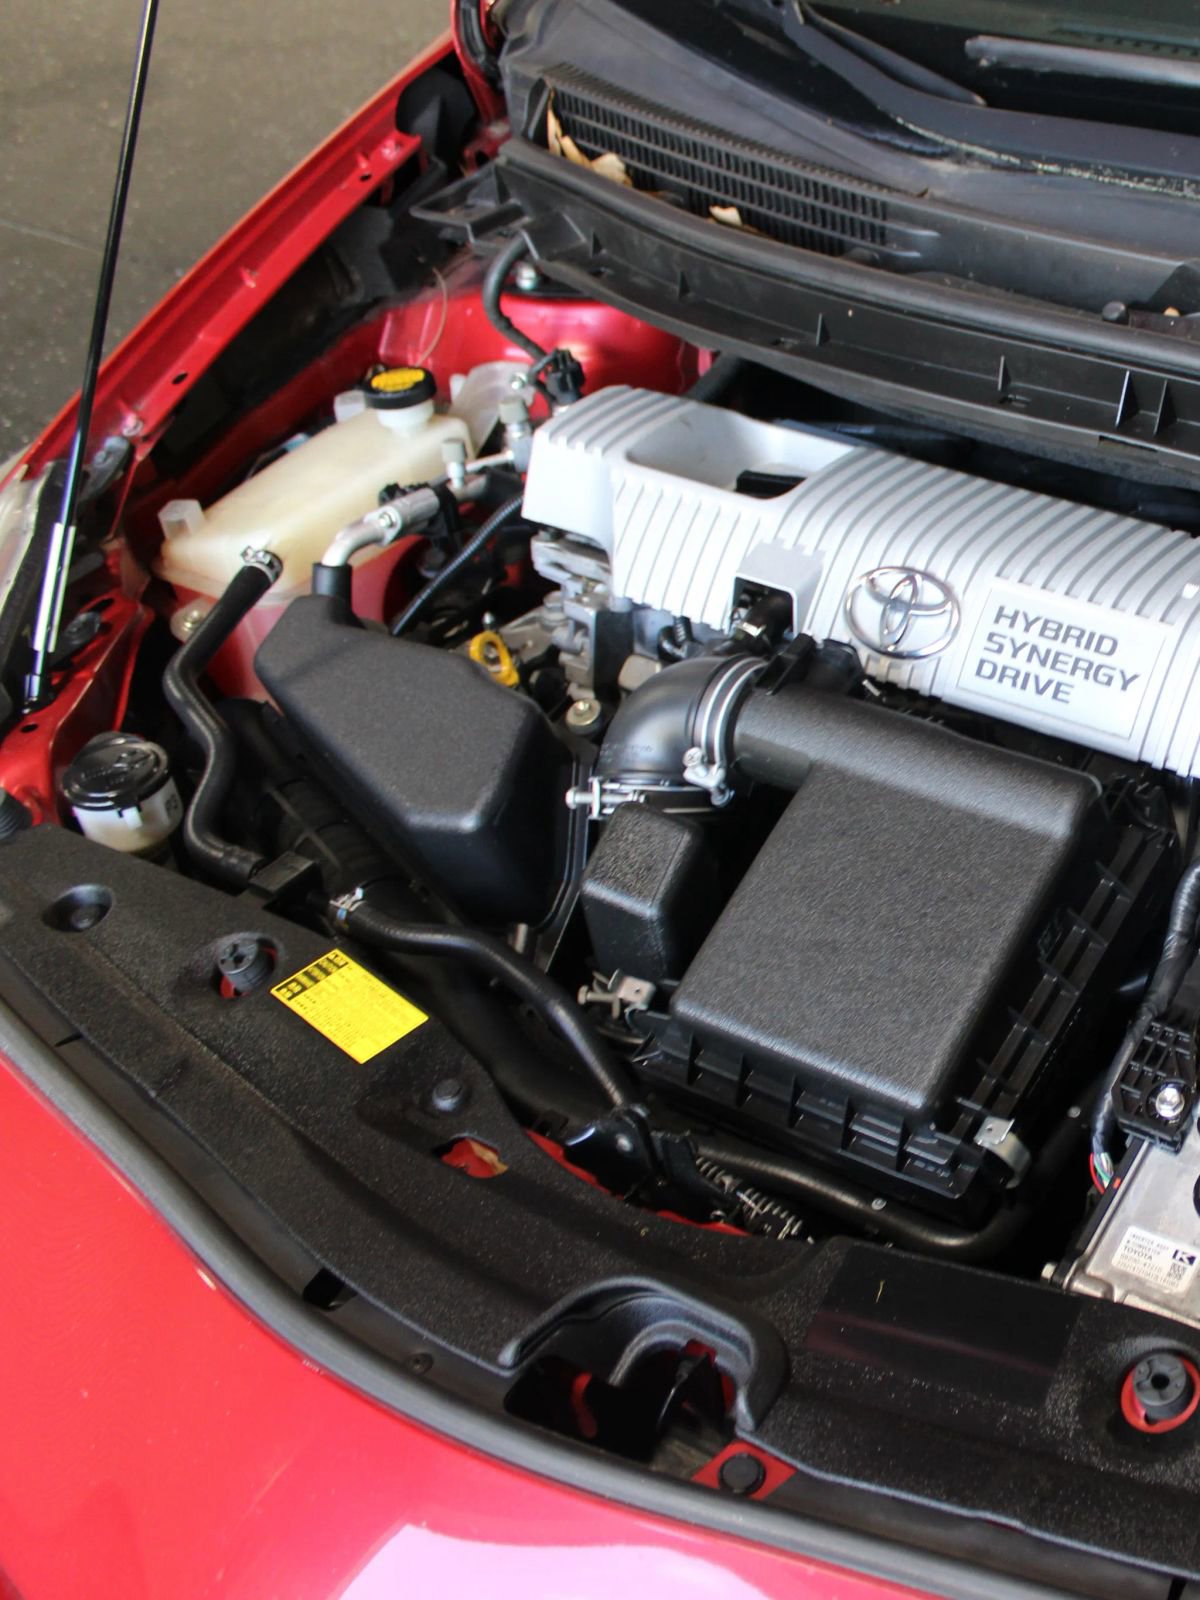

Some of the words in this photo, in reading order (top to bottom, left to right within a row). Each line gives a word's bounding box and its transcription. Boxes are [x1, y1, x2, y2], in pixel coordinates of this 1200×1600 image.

[993, 605, 1118, 656] HYBRID
[975, 658, 1074, 704] DRIVE
[983, 631, 1140, 692] SYNERGY
[1123, 1245, 1153, 1261] TOYOTA
